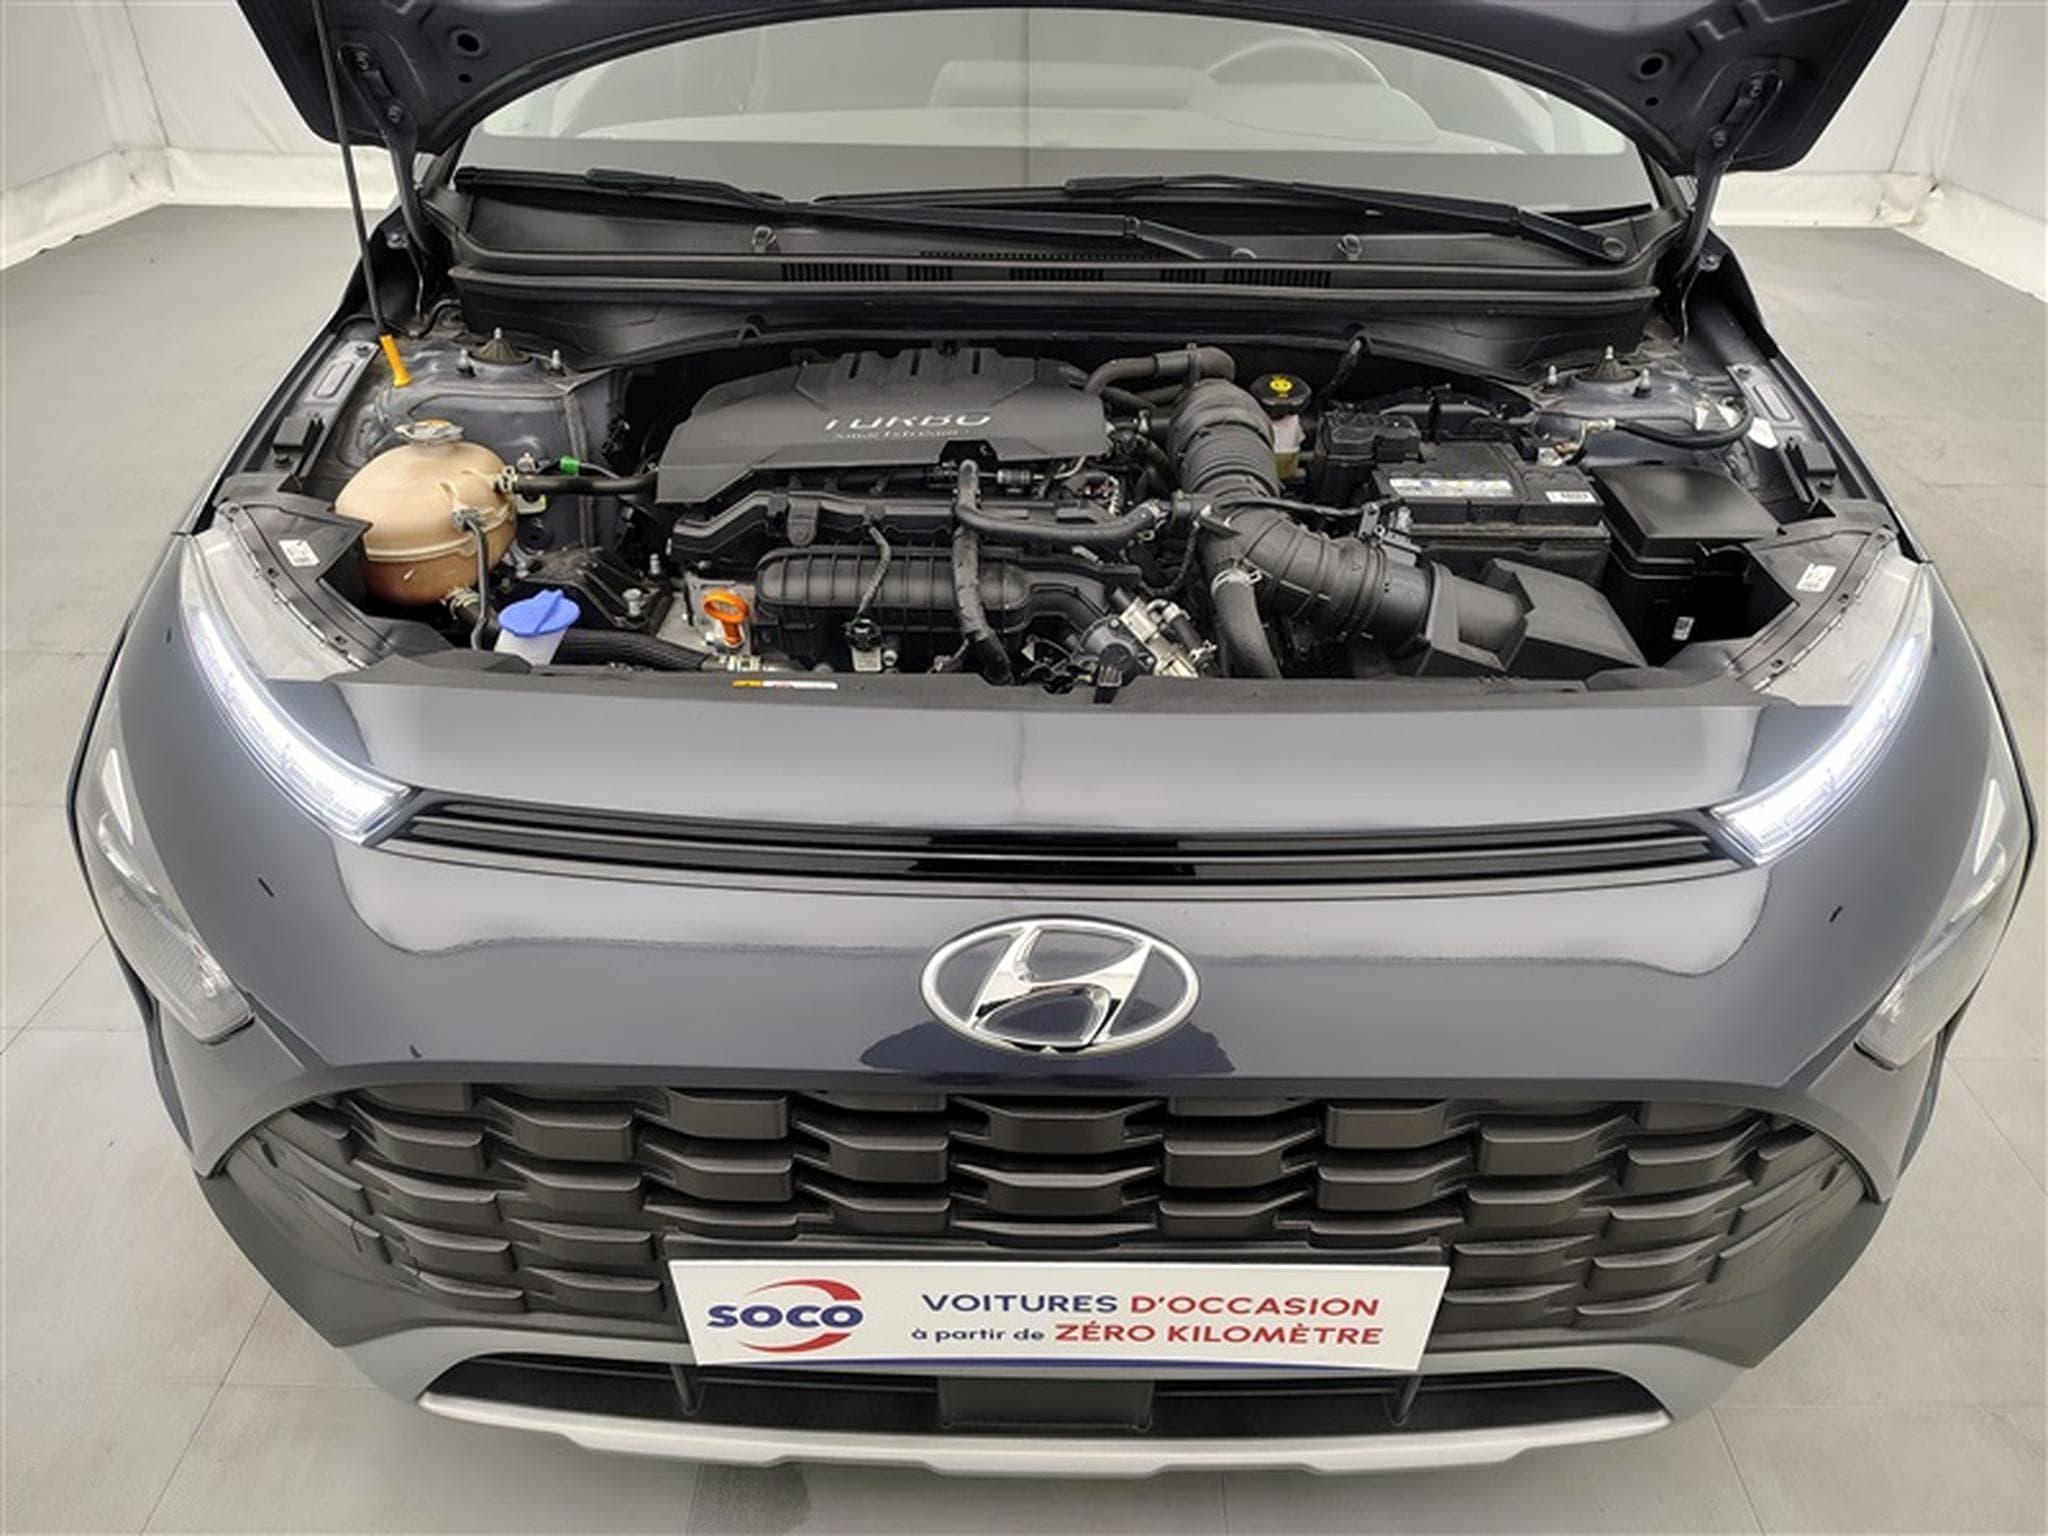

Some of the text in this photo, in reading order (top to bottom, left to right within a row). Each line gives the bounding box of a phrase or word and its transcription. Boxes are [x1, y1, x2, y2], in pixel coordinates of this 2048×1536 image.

[921, 1293, 1380, 1316] VOITURES D'OCCASION
[706, 1305, 864, 1328] SOCO
[911, 1319, 1383, 1345] à partir de ZÉRO KILOMÈTRE
